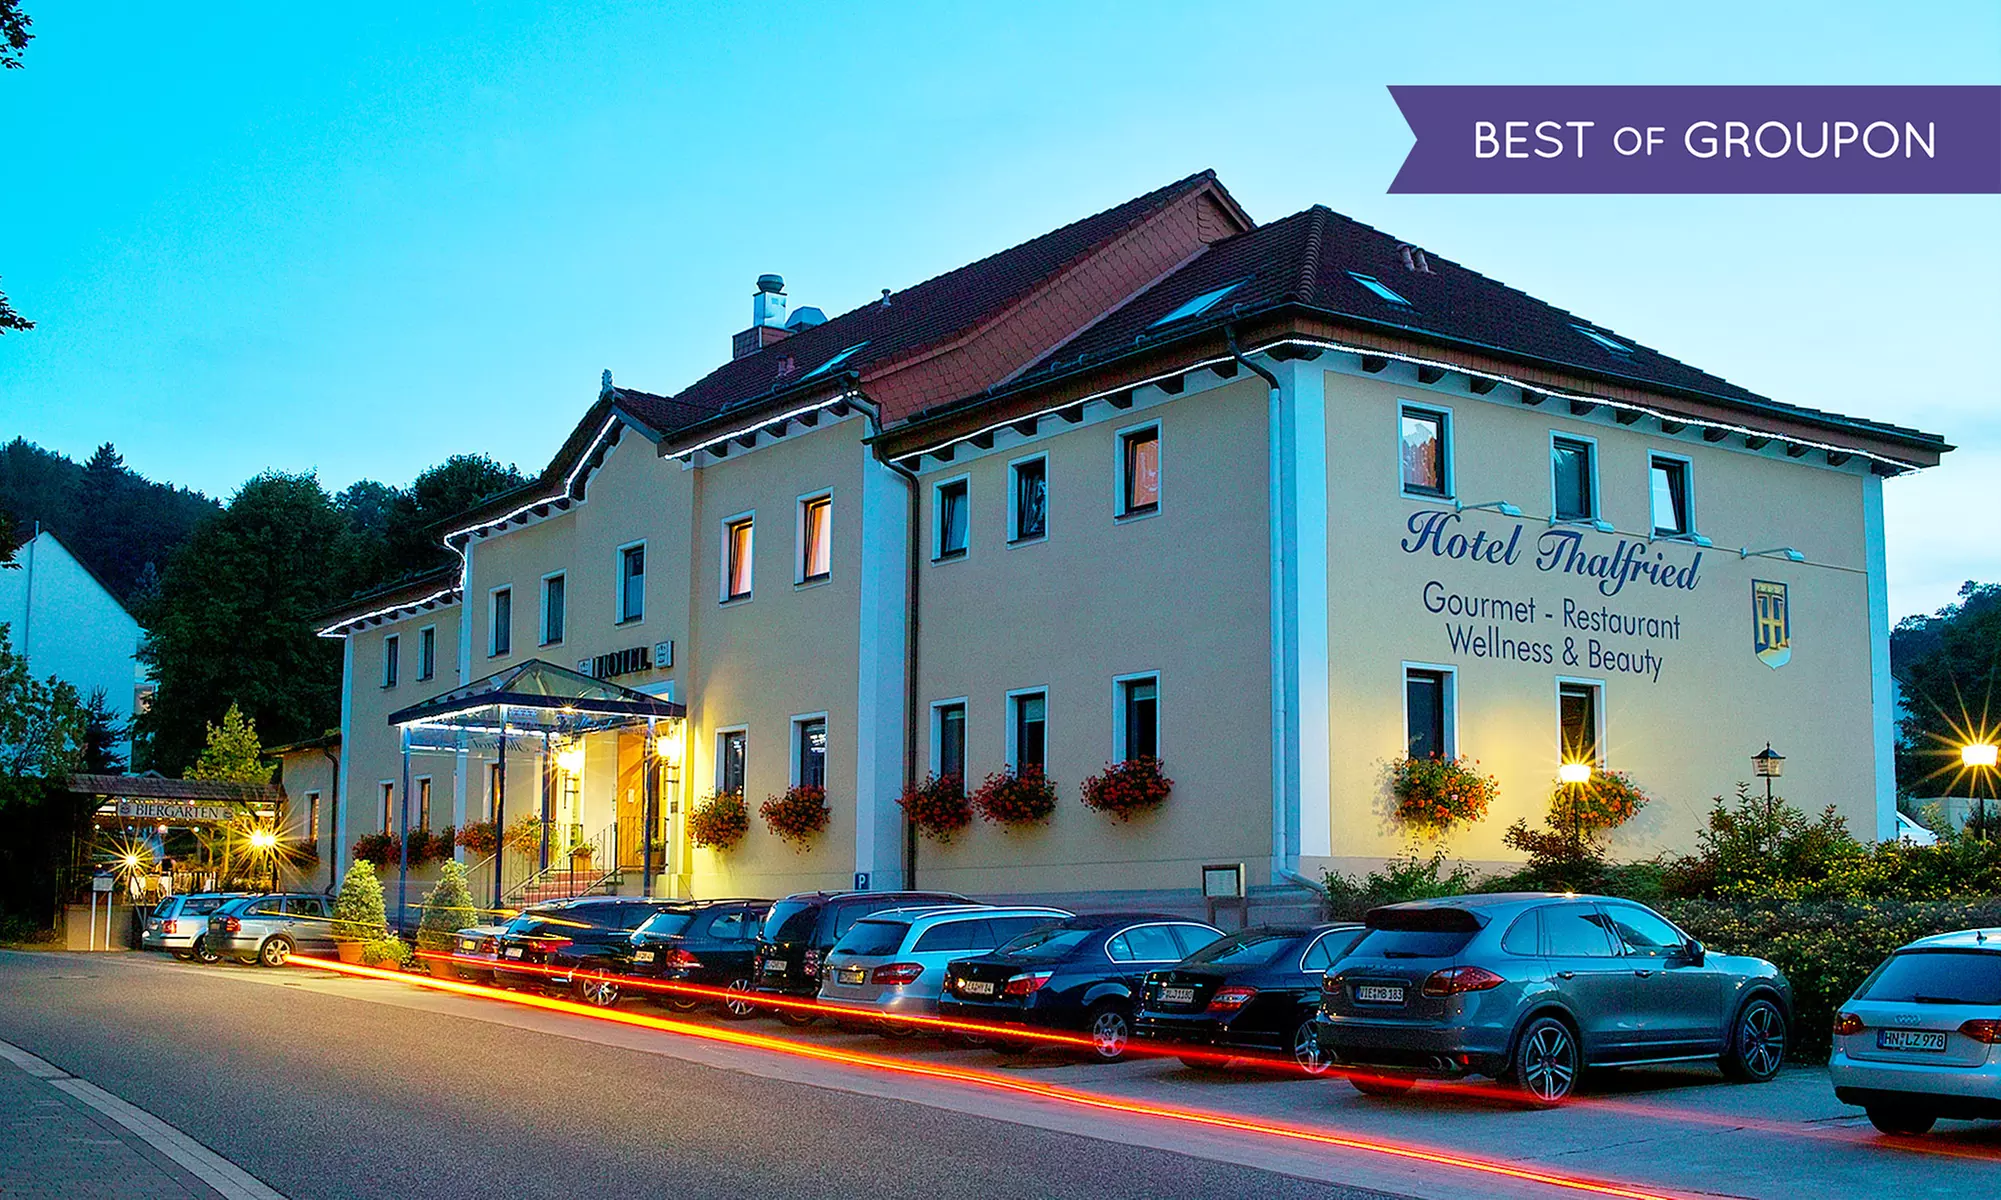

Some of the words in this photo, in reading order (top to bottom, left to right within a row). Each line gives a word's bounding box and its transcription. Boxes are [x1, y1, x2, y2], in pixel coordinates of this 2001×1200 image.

[1401, 510, 1523, 566] Hotel
[1536, 529, 1702, 597] Thalfried
[1423, 581, 1536, 624] Gourmet
[1563, 597, 1681, 640] Restaurant
[593, 646, 652, 678] HOTEL
[1446, 622, 1553, 664] Wellness
[1562, 636, 1579, 667] &
[1588, 639, 1663, 683] Beauty
[135, 803, 219, 819] BIERGARTEN
[858, 874, 866, 889] P
[1922, 1035, 1944, 1048] 978
